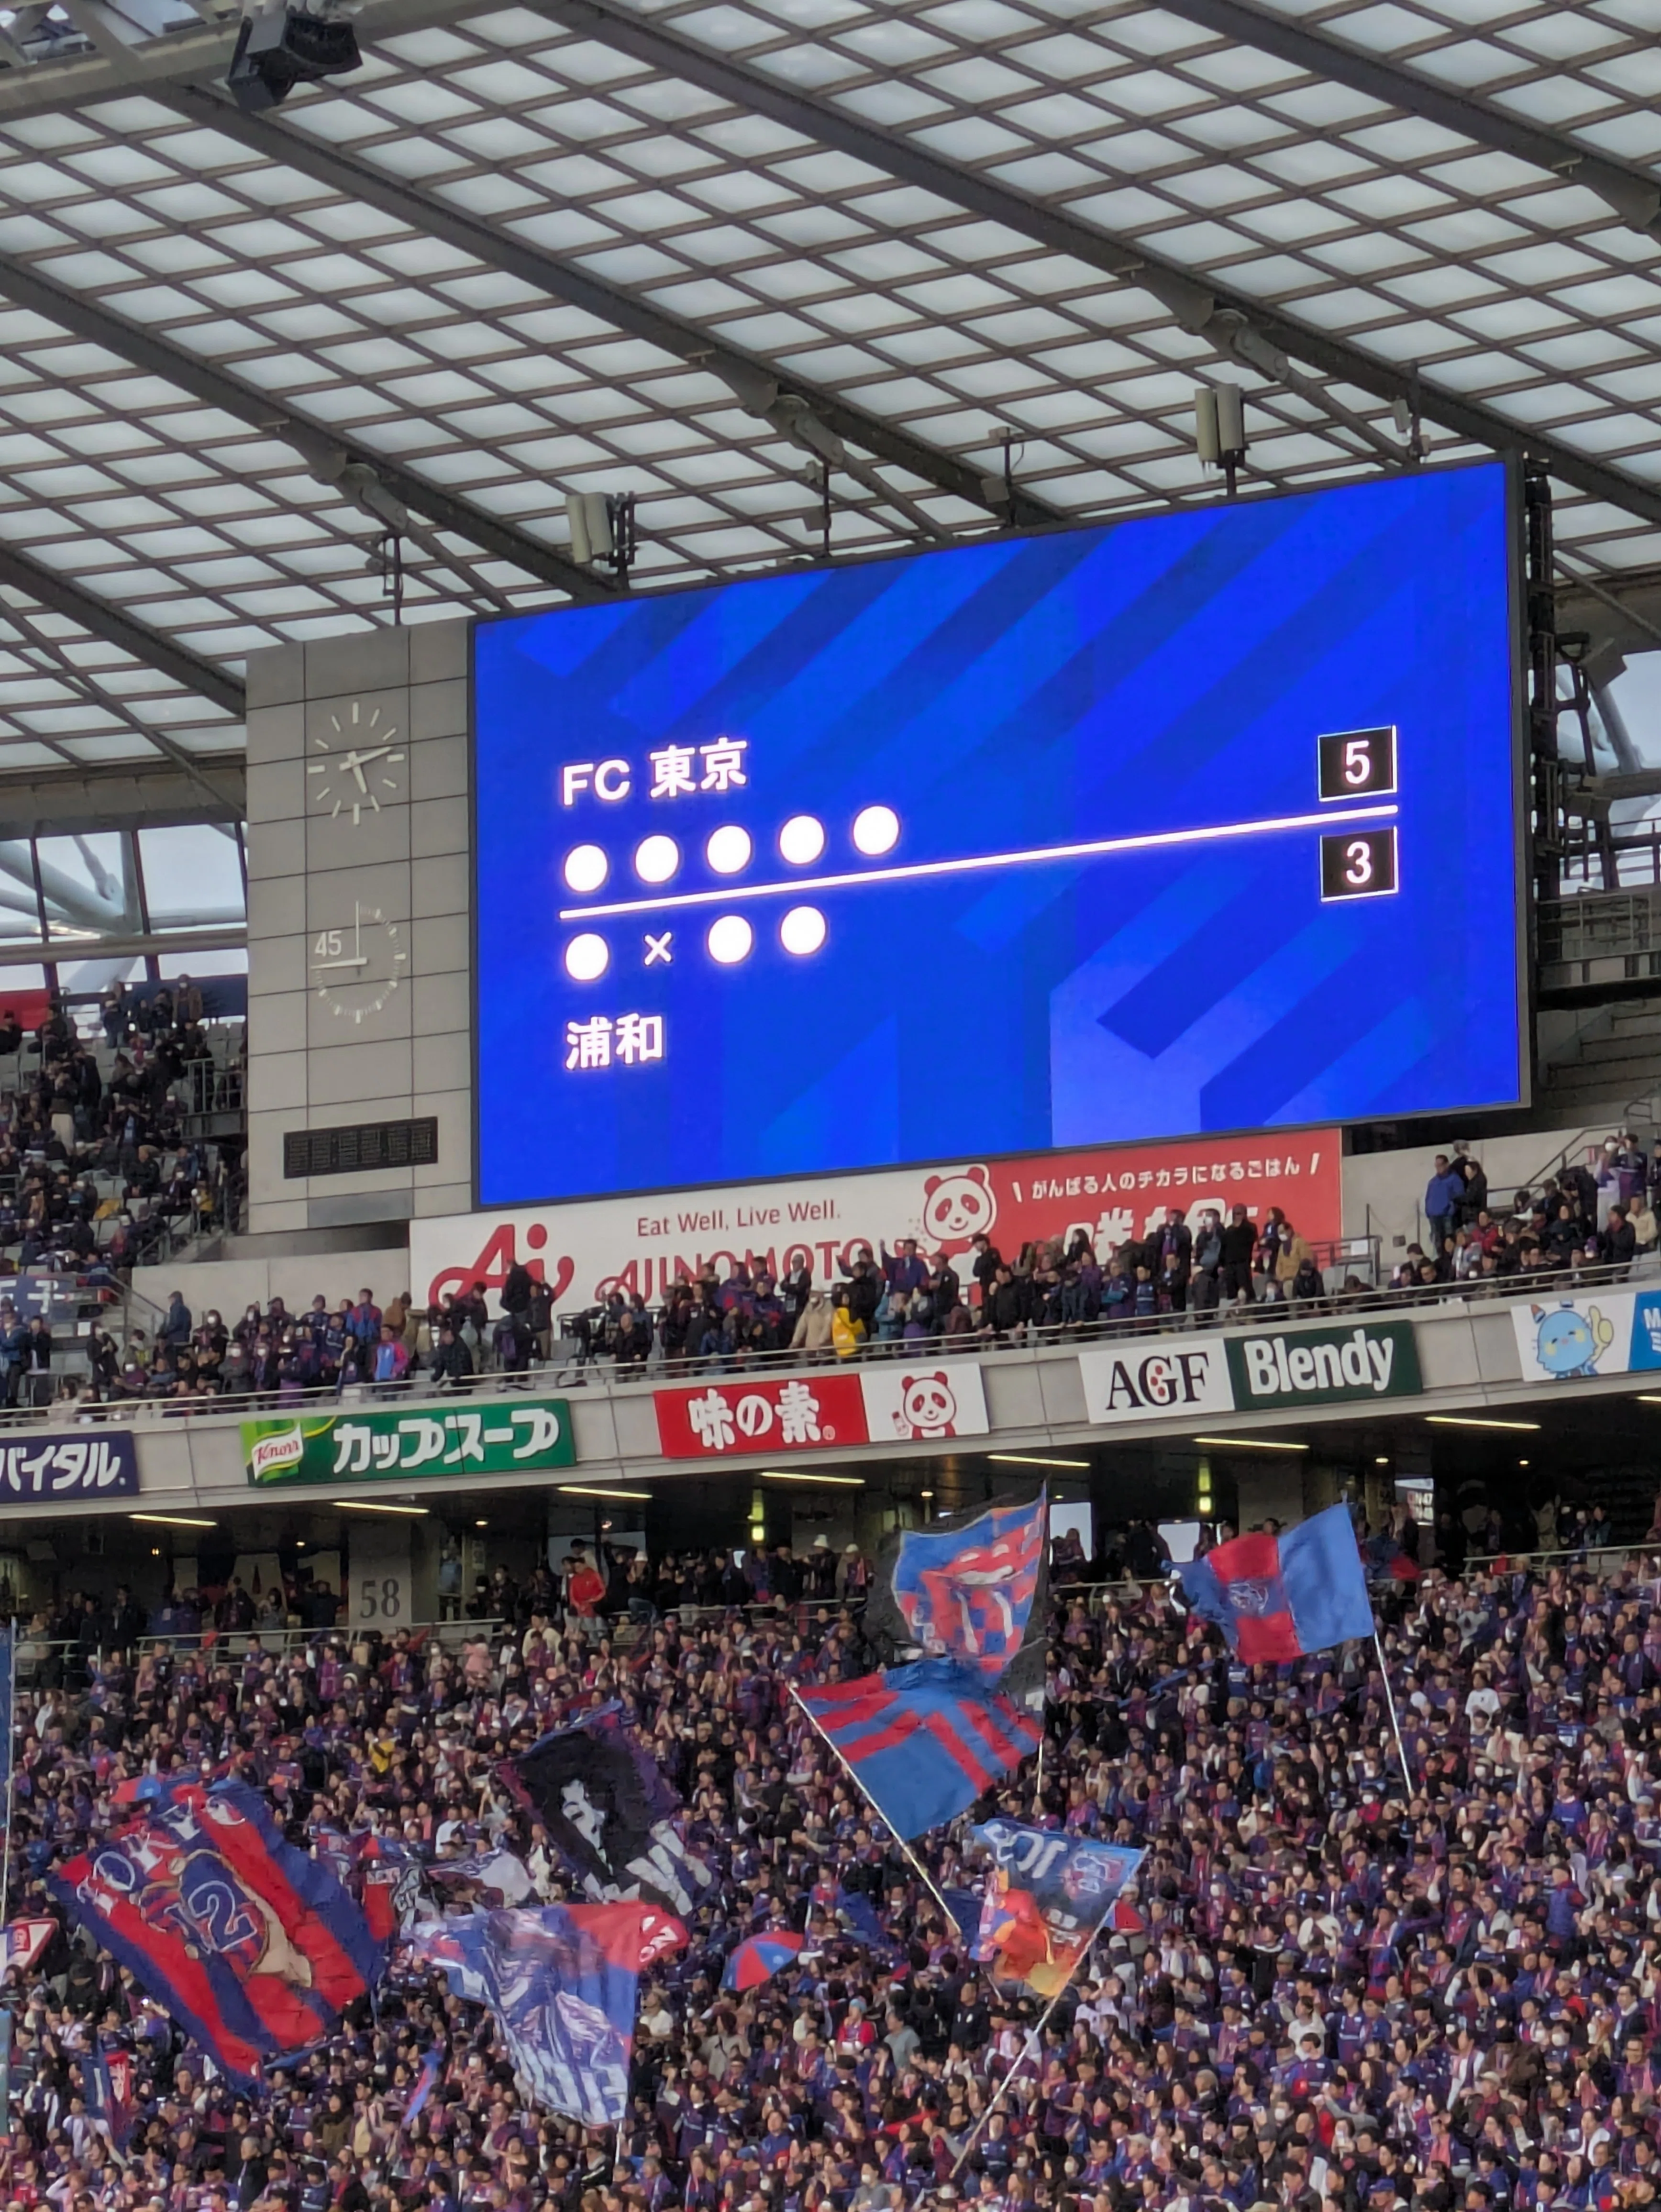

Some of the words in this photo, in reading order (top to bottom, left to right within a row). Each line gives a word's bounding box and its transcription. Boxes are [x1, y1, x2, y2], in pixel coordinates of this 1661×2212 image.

[563, 760, 631, 805] FC
[649, 737, 748, 798] 東京
[1345, 740, 1370, 784] 5
[1346, 841, 1372, 884] 3
[314, 931, 342, 957] 45
[566, 1013, 663, 1069] 浦和
[637, 1215, 670, 1237] Eat
[677, 1209, 729, 1233] Well,
[737, 1205, 781, 1227] Live
[787, 1199, 841, 1222] Well.
[1106, 1352, 1209, 1410] AGF
[1244, 1329, 1394, 1395] Blendy
[255, 1440, 299, 1465] Knorr
[333, 1408, 559, 1473] カップスープ
[360, 1580, 400, 1618] 58
